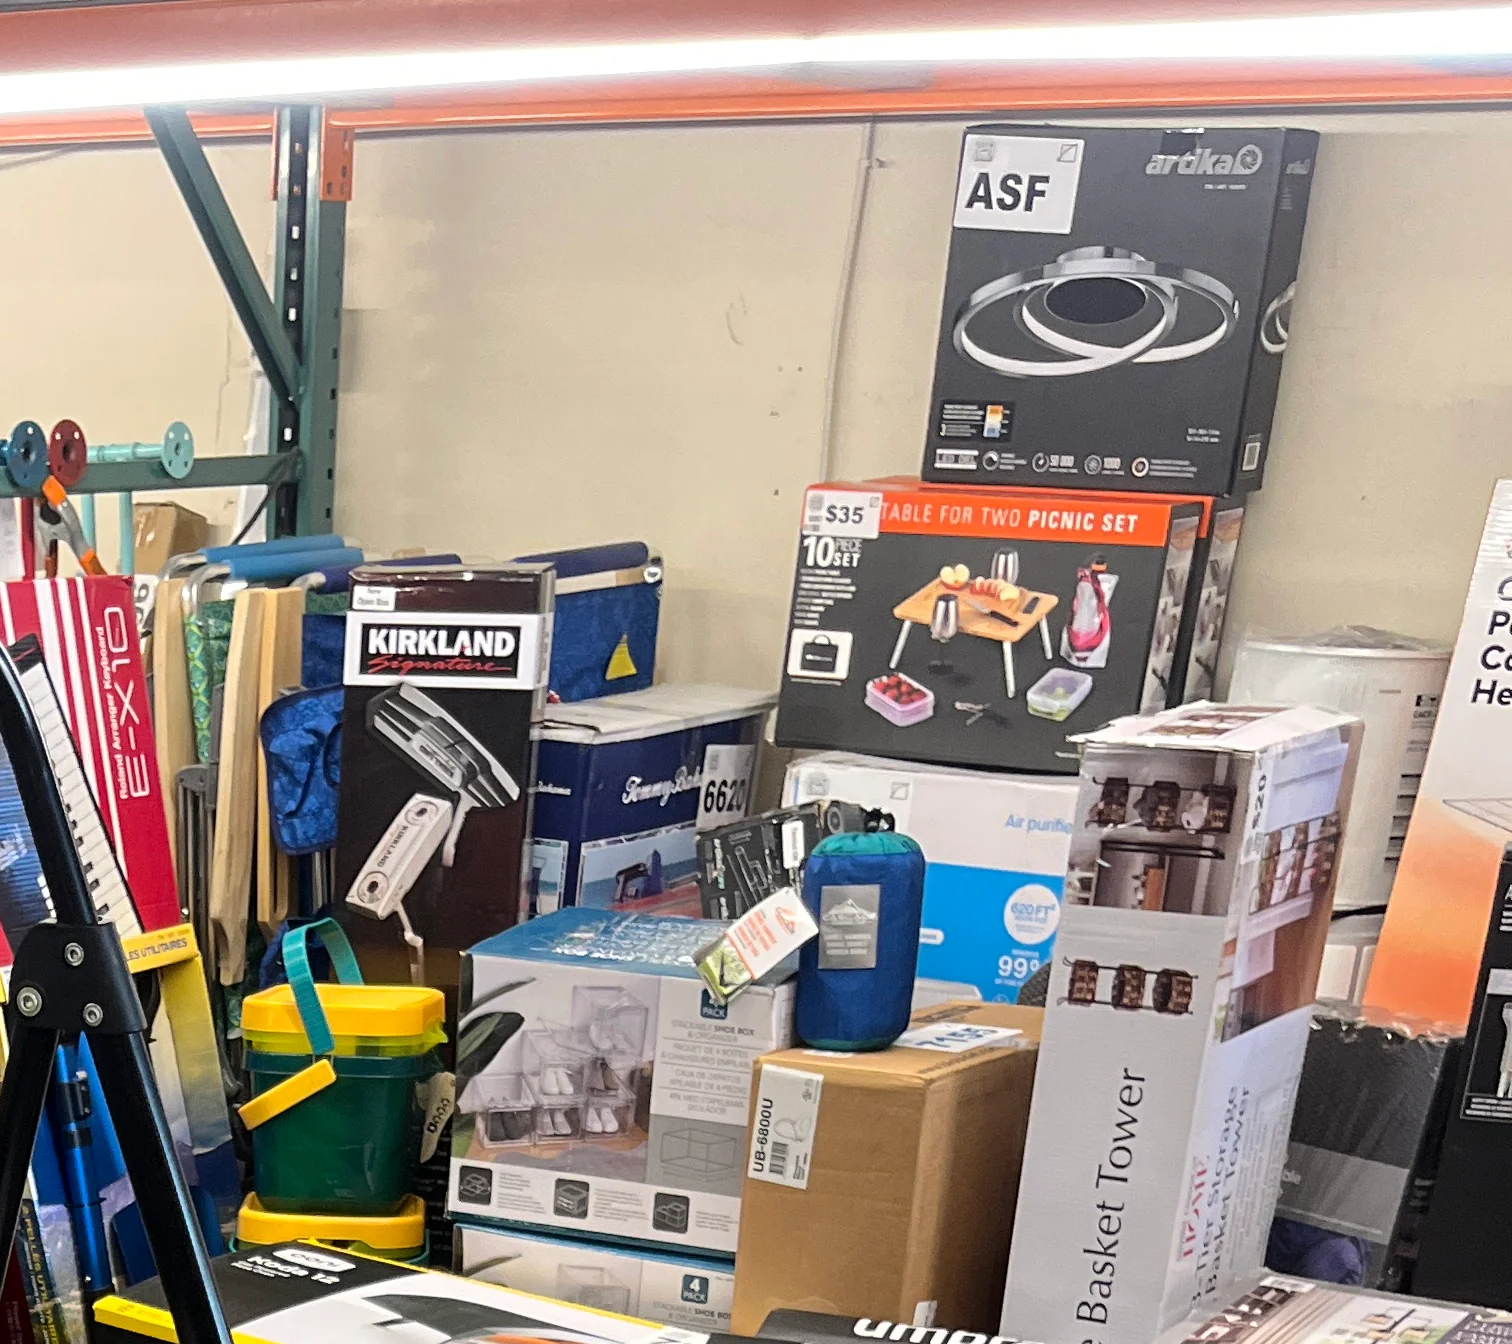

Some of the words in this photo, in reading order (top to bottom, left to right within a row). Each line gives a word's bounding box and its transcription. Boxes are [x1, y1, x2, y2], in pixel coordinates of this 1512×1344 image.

[965, 172, 1050, 212] ASF
[825, 505, 864, 524] $35
[880, 502, 932, 524] TABLE
[940, 504, 973, 525] FOR
[981, 507, 1021, 528] TWO
[1027, 508, 1094, 532] PICNIC
[1101, 513, 1139, 533] SET
[803, 536, 834, 567] 10
[833, 552, 862, 568] SET
[95, 626, 113, 691] Keyboard
[367, 628, 516, 659] KIRKLAND
[366, 653, 513, 676] Signature
[104, 694, 121, 752] Arranger
[111, 753, 128, 801] Roland
[703, 779, 746, 814] 6620
[1005, 814, 1023, 830] Air
[702, 1007, 726, 1018] PACK
[752, 1097, 774, 1173] UB-6800U
[1095, 1066, 1146, 1190] Tower
[1075, 1200, 1126, 1325] Basket
[682, 1292, 706, 1302] PACK
[688, 1277, 700, 1292] 4
[693, 1308, 716, 1319] SHOE
